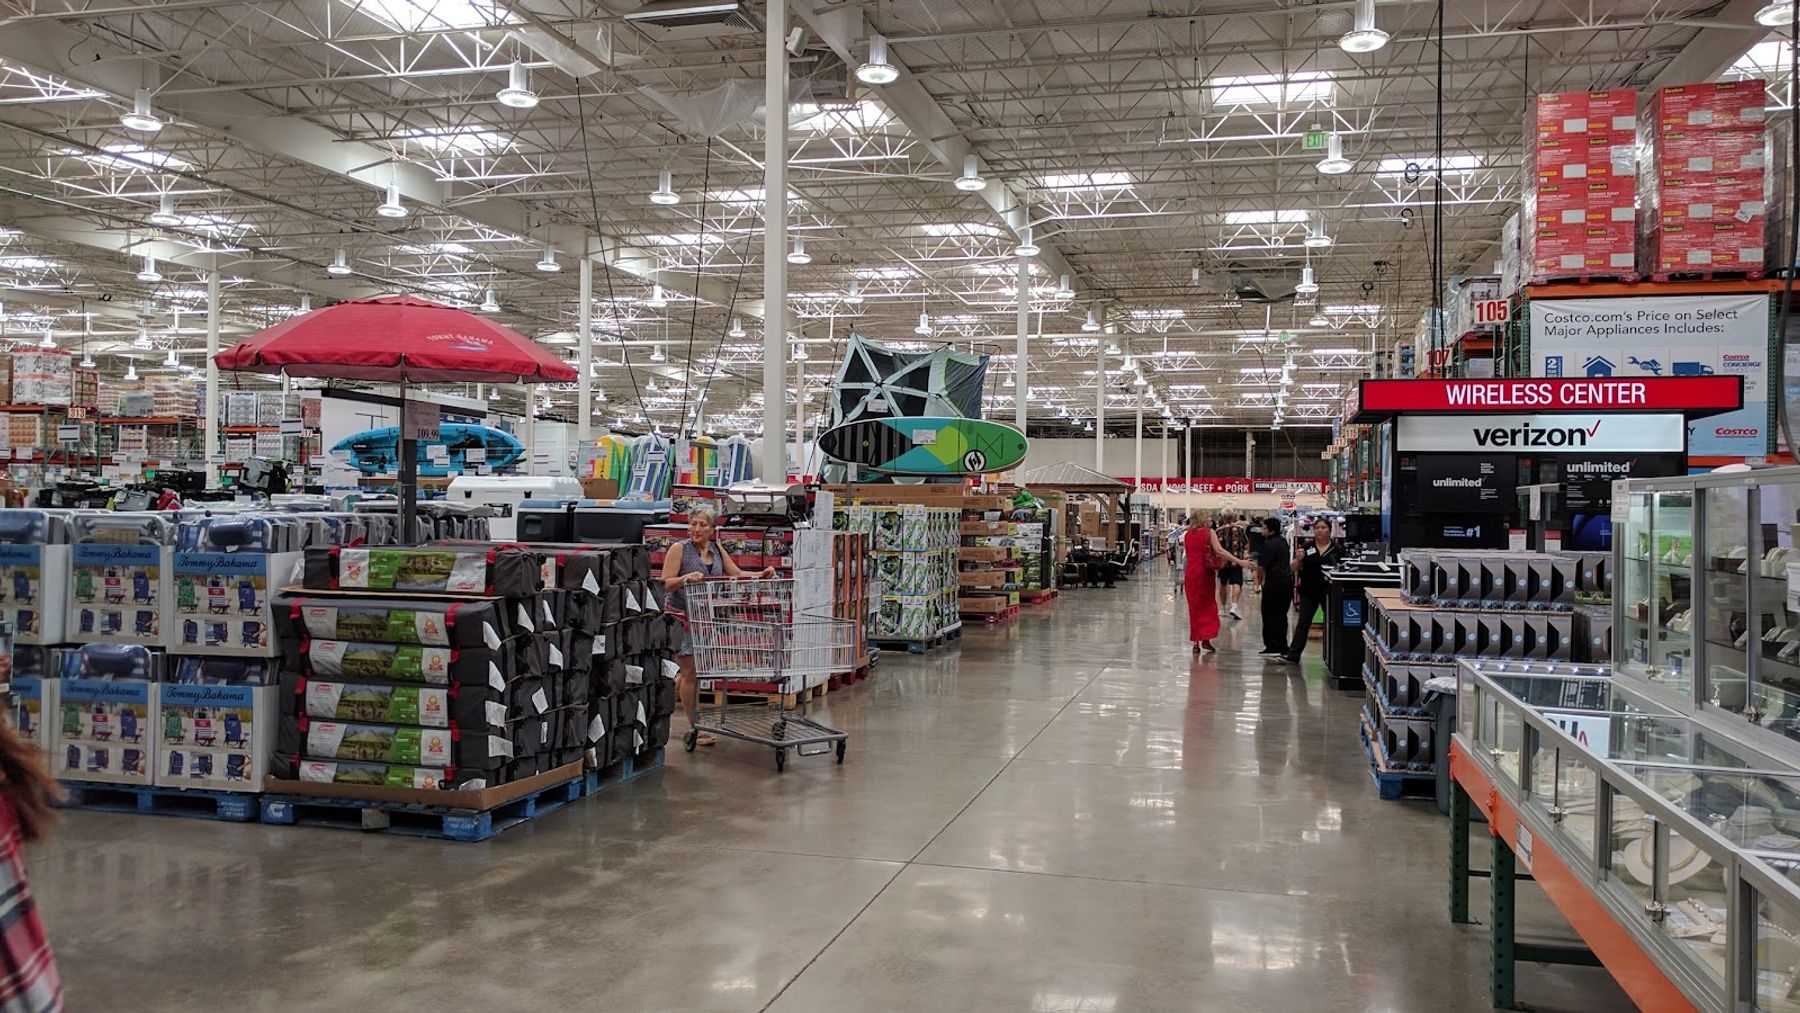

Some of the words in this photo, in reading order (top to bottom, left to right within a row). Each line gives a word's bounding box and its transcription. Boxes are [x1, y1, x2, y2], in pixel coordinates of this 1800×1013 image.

[1306, 133, 1326, 148] EXIT
[1476, 301, 1508, 322] 105
[1544, 310, 1632, 324] Costco.com's
[1637, 310, 1670, 322] Price
[1674, 312, 1692, 321] on
[1696, 308, 1738, 320] Select
[1544, 325, 1582, 339] Major
[1586, 324, 1660, 338] Appliances
[1664, 322, 1724, 334] Includes:
[1427, 349, 1450, 366] 107
[1547, 358, 1557, 369] 2
[1446, 382, 1553, 405] WIRELESS
[1560, 382, 1646, 404] CENTER
[417, 428, 439, 440] 109.99
[1473, 422, 1586, 447] verizon
[1716, 428, 1758, 438] COSTCO
[1567, 462, 1630, 473] unlimited
[1433, 478, 1482, 487] unlimited
[1466, 526, 1480, 537] #1
[79, 546, 112, 562] Tommy
[112, 548, 151, 559] Bahama
[178, 556, 216, 571] Tommy
[214, 556, 257, 568] Bahama
[65, 681, 99, 698] Tommy
[100, 683, 140, 696] Bahama
[167, 687, 202, 703] Tommy
[201, 688, 244, 700] Bahama
